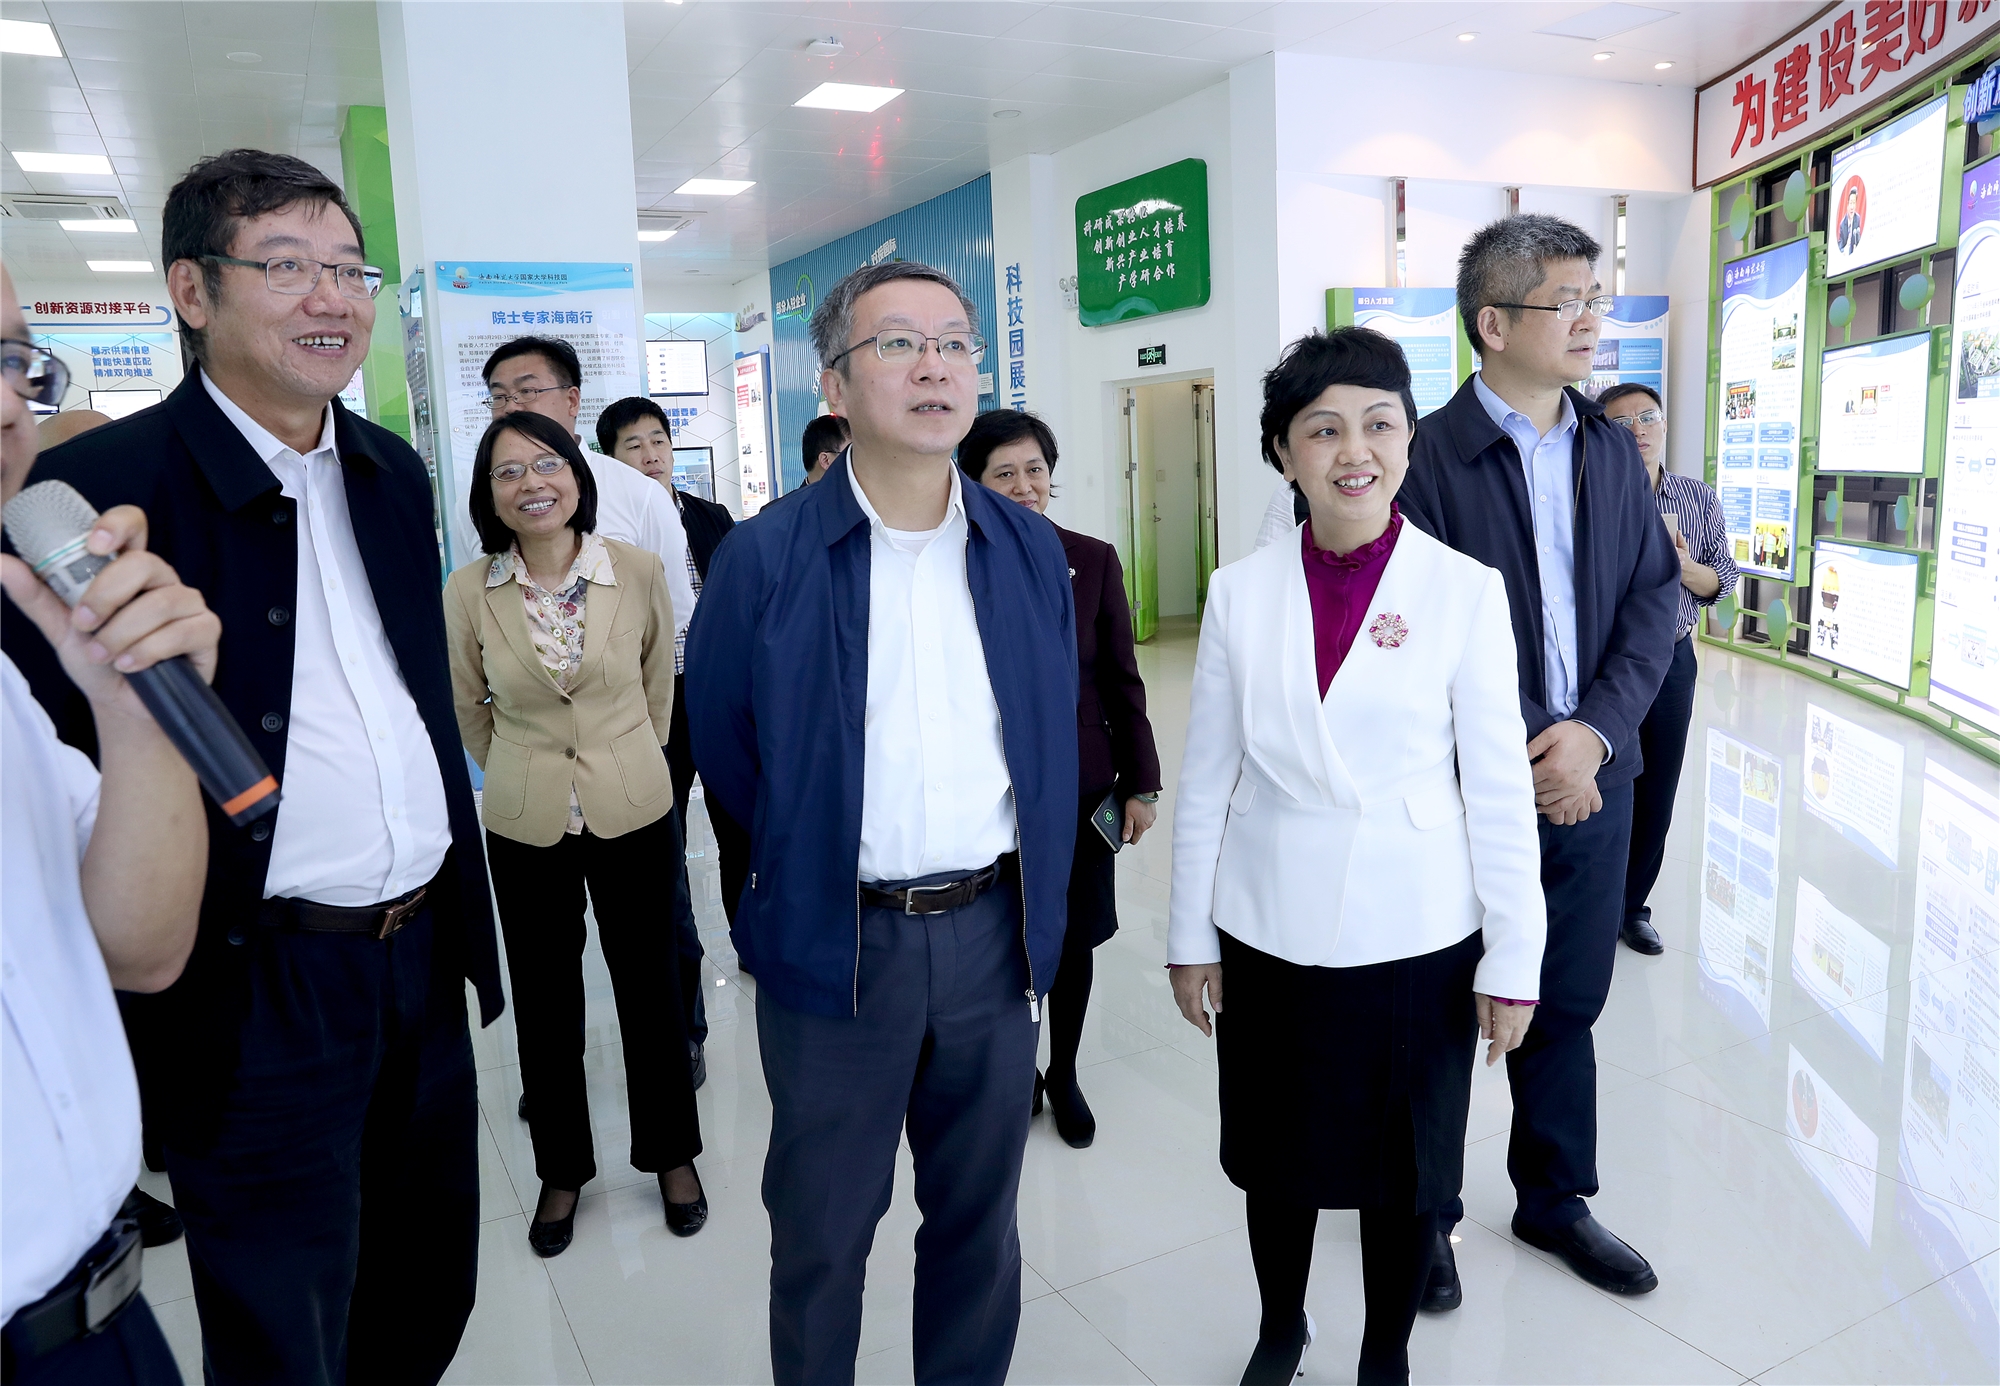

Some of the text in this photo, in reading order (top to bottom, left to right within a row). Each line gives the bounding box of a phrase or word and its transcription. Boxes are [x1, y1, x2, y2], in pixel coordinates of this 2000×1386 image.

[1731, 0, 2000, 158] 为建设美好
[1083, 205, 1148, 237] 科研成果转化
[1093, 212, 1187, 254] 创新创业人才培养
[1105, 239, 1175, 272] 新兴产业培育
[1118, 262, 1176, 292] 产学研合作
[34, 301, 151, 315] 创新资源对接平台
[492, 310, 593, 325] 院士专家海南行
[91, 346, 150, 355] 展示供需信息
[93, 357, 152, 367] 智能快速匹配
[94, 368, 153, 378] 精准双向推送
